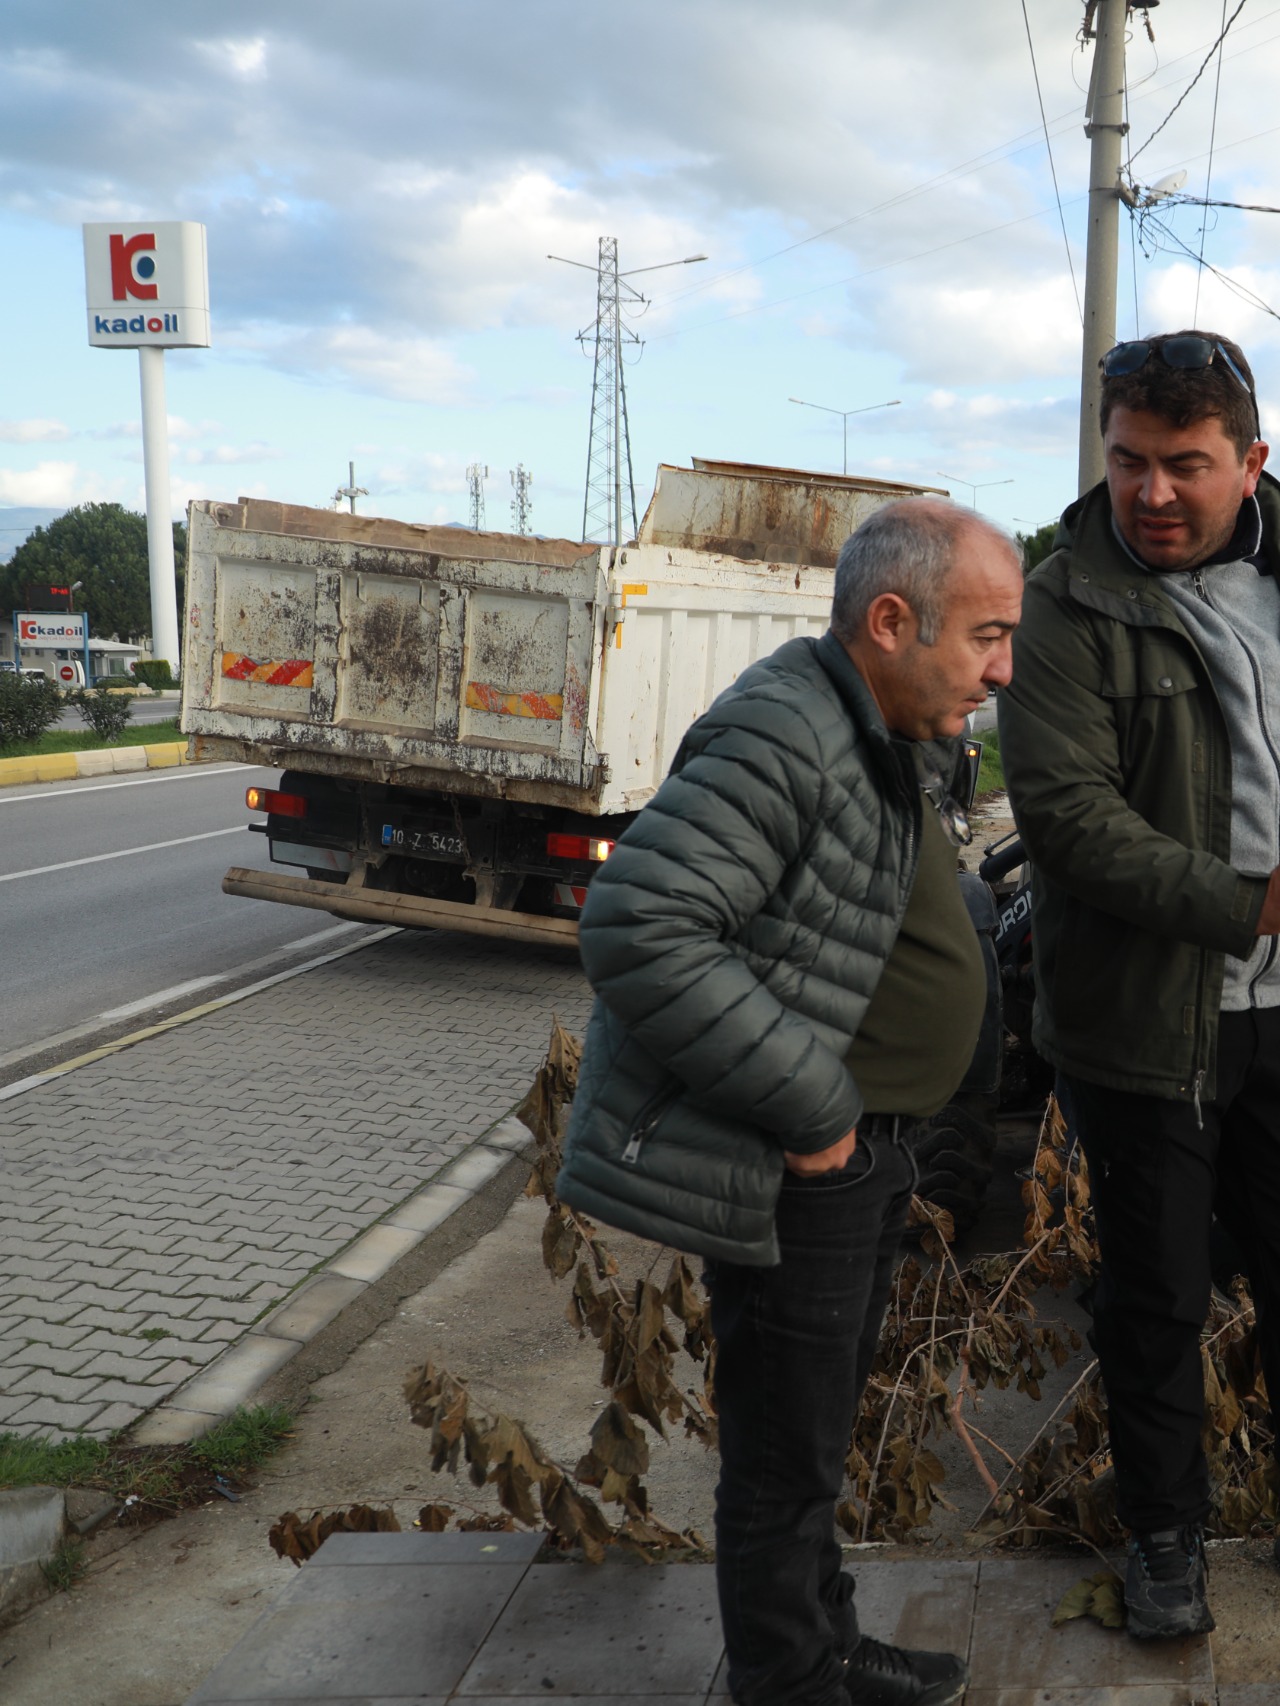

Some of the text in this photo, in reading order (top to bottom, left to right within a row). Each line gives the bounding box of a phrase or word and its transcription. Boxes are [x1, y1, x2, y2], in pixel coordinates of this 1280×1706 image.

[95, 313, 178, 334] kadoil
[38, 625, 82, 636] kadoil
[393, 829, 404, 845] 10
